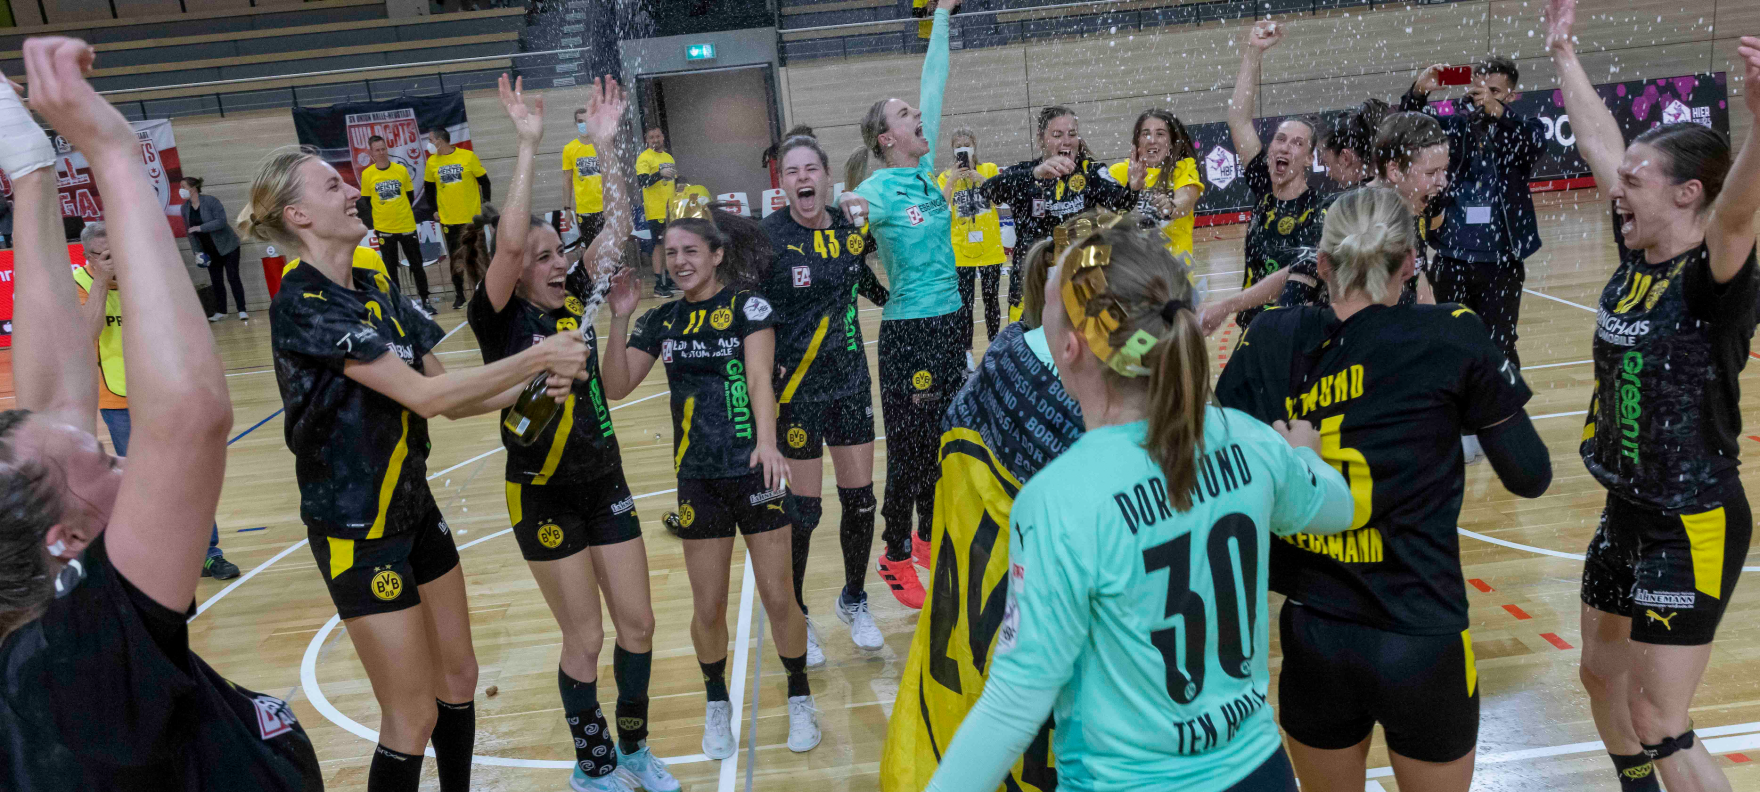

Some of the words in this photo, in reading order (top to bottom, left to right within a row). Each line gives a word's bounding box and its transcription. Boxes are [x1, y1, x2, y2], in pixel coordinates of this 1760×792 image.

[813, 230, 840, 258] 43
[849, 236, 863, 249] BVB
[795, 267, 811, 286] EA
[713, 311, 730, 323] BVB
[915, 373, 930, 385] BVB
[1000, 352, 1038, 405] BORUSSIA
[1036, 398, 1086, 440] DORTM
[789, 430, 805, 443] BVB
[679, 508, 692, 521] BVB
[541, 527, 561, 544] BVB
[376, 574, 400, 593] BVB
[1142, 512, 1258, 705] 30
[620, 719, 640, 727] BVB
[1173, 711, 1217, 755] TEN
